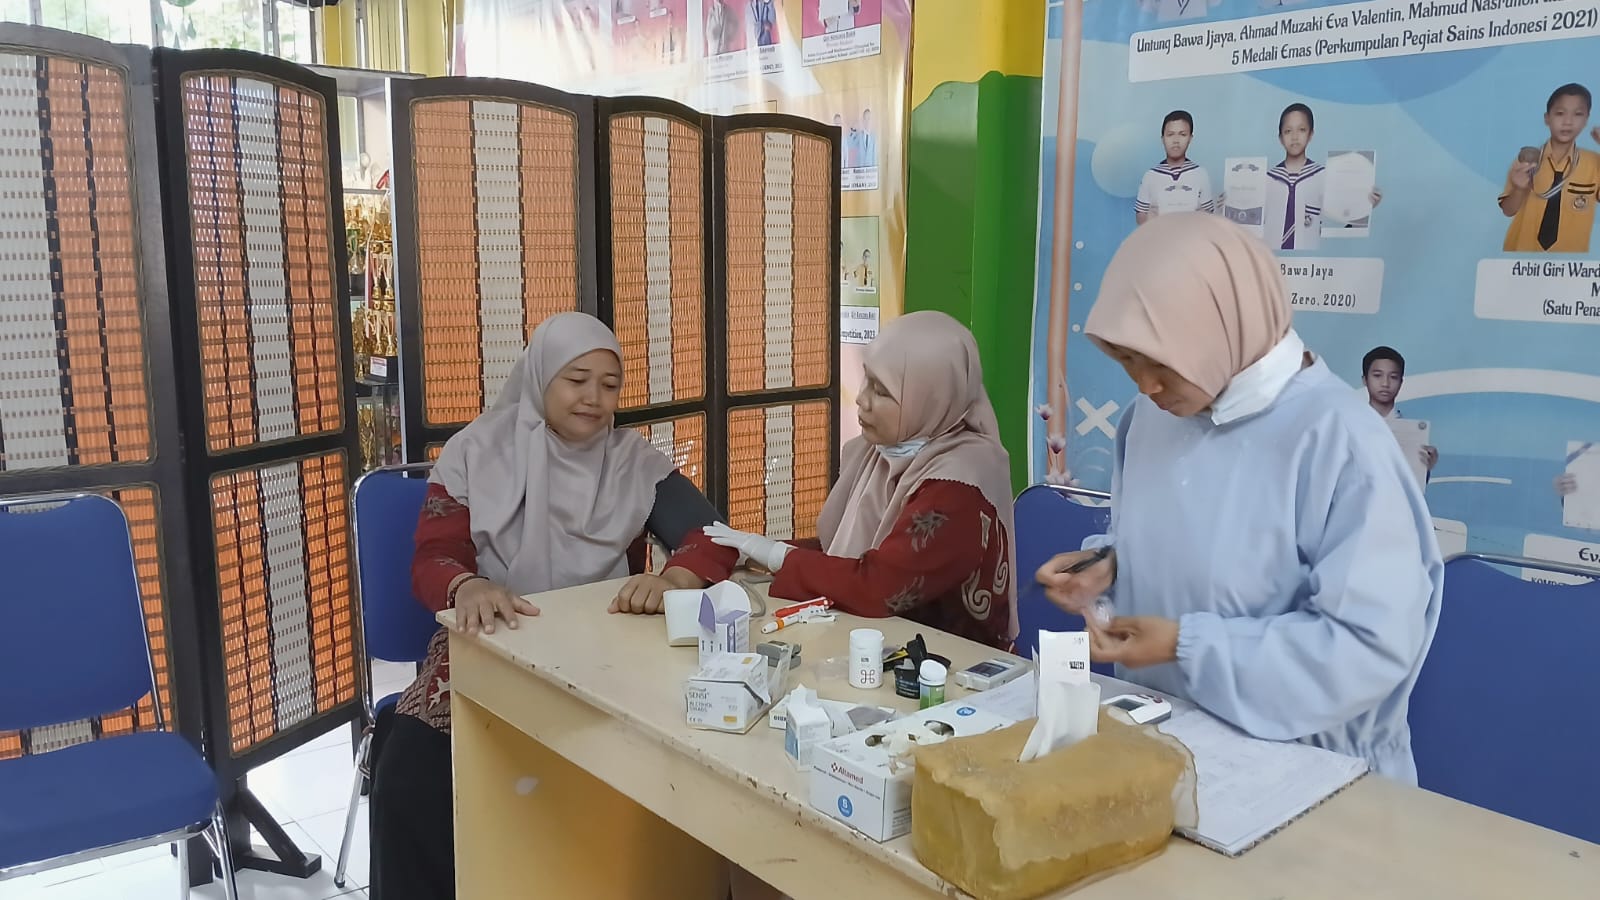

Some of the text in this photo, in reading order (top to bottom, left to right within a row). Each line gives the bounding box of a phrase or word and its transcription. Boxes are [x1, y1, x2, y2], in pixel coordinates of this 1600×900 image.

[1137, 38, 1171, 54] Untung
[1173, 33, 1204, 48] Bawa
[1240, 21, 1278, 40] Ahmad
[1280, 15, 1323, 34] Muzaki
[1326, 13, 1348, 29] Eva
[1408, 2, 1468, 20] Mahmud
[1231, 7, 1599, 66] 5 Medali Emas (Perkumpulan Pegiat Sains Indonesi 2021)
[1280, 263, 1334, 281] Bawa Jaya
[1512, 261, 1540, 277] Arbit
[1543, 261, 1565, 277] Giri
[1323, 293, 1356, 307] 2020)
[1543, 299, 1572, 316] (Satu
[1578, 547, 1600, 563] Ev
